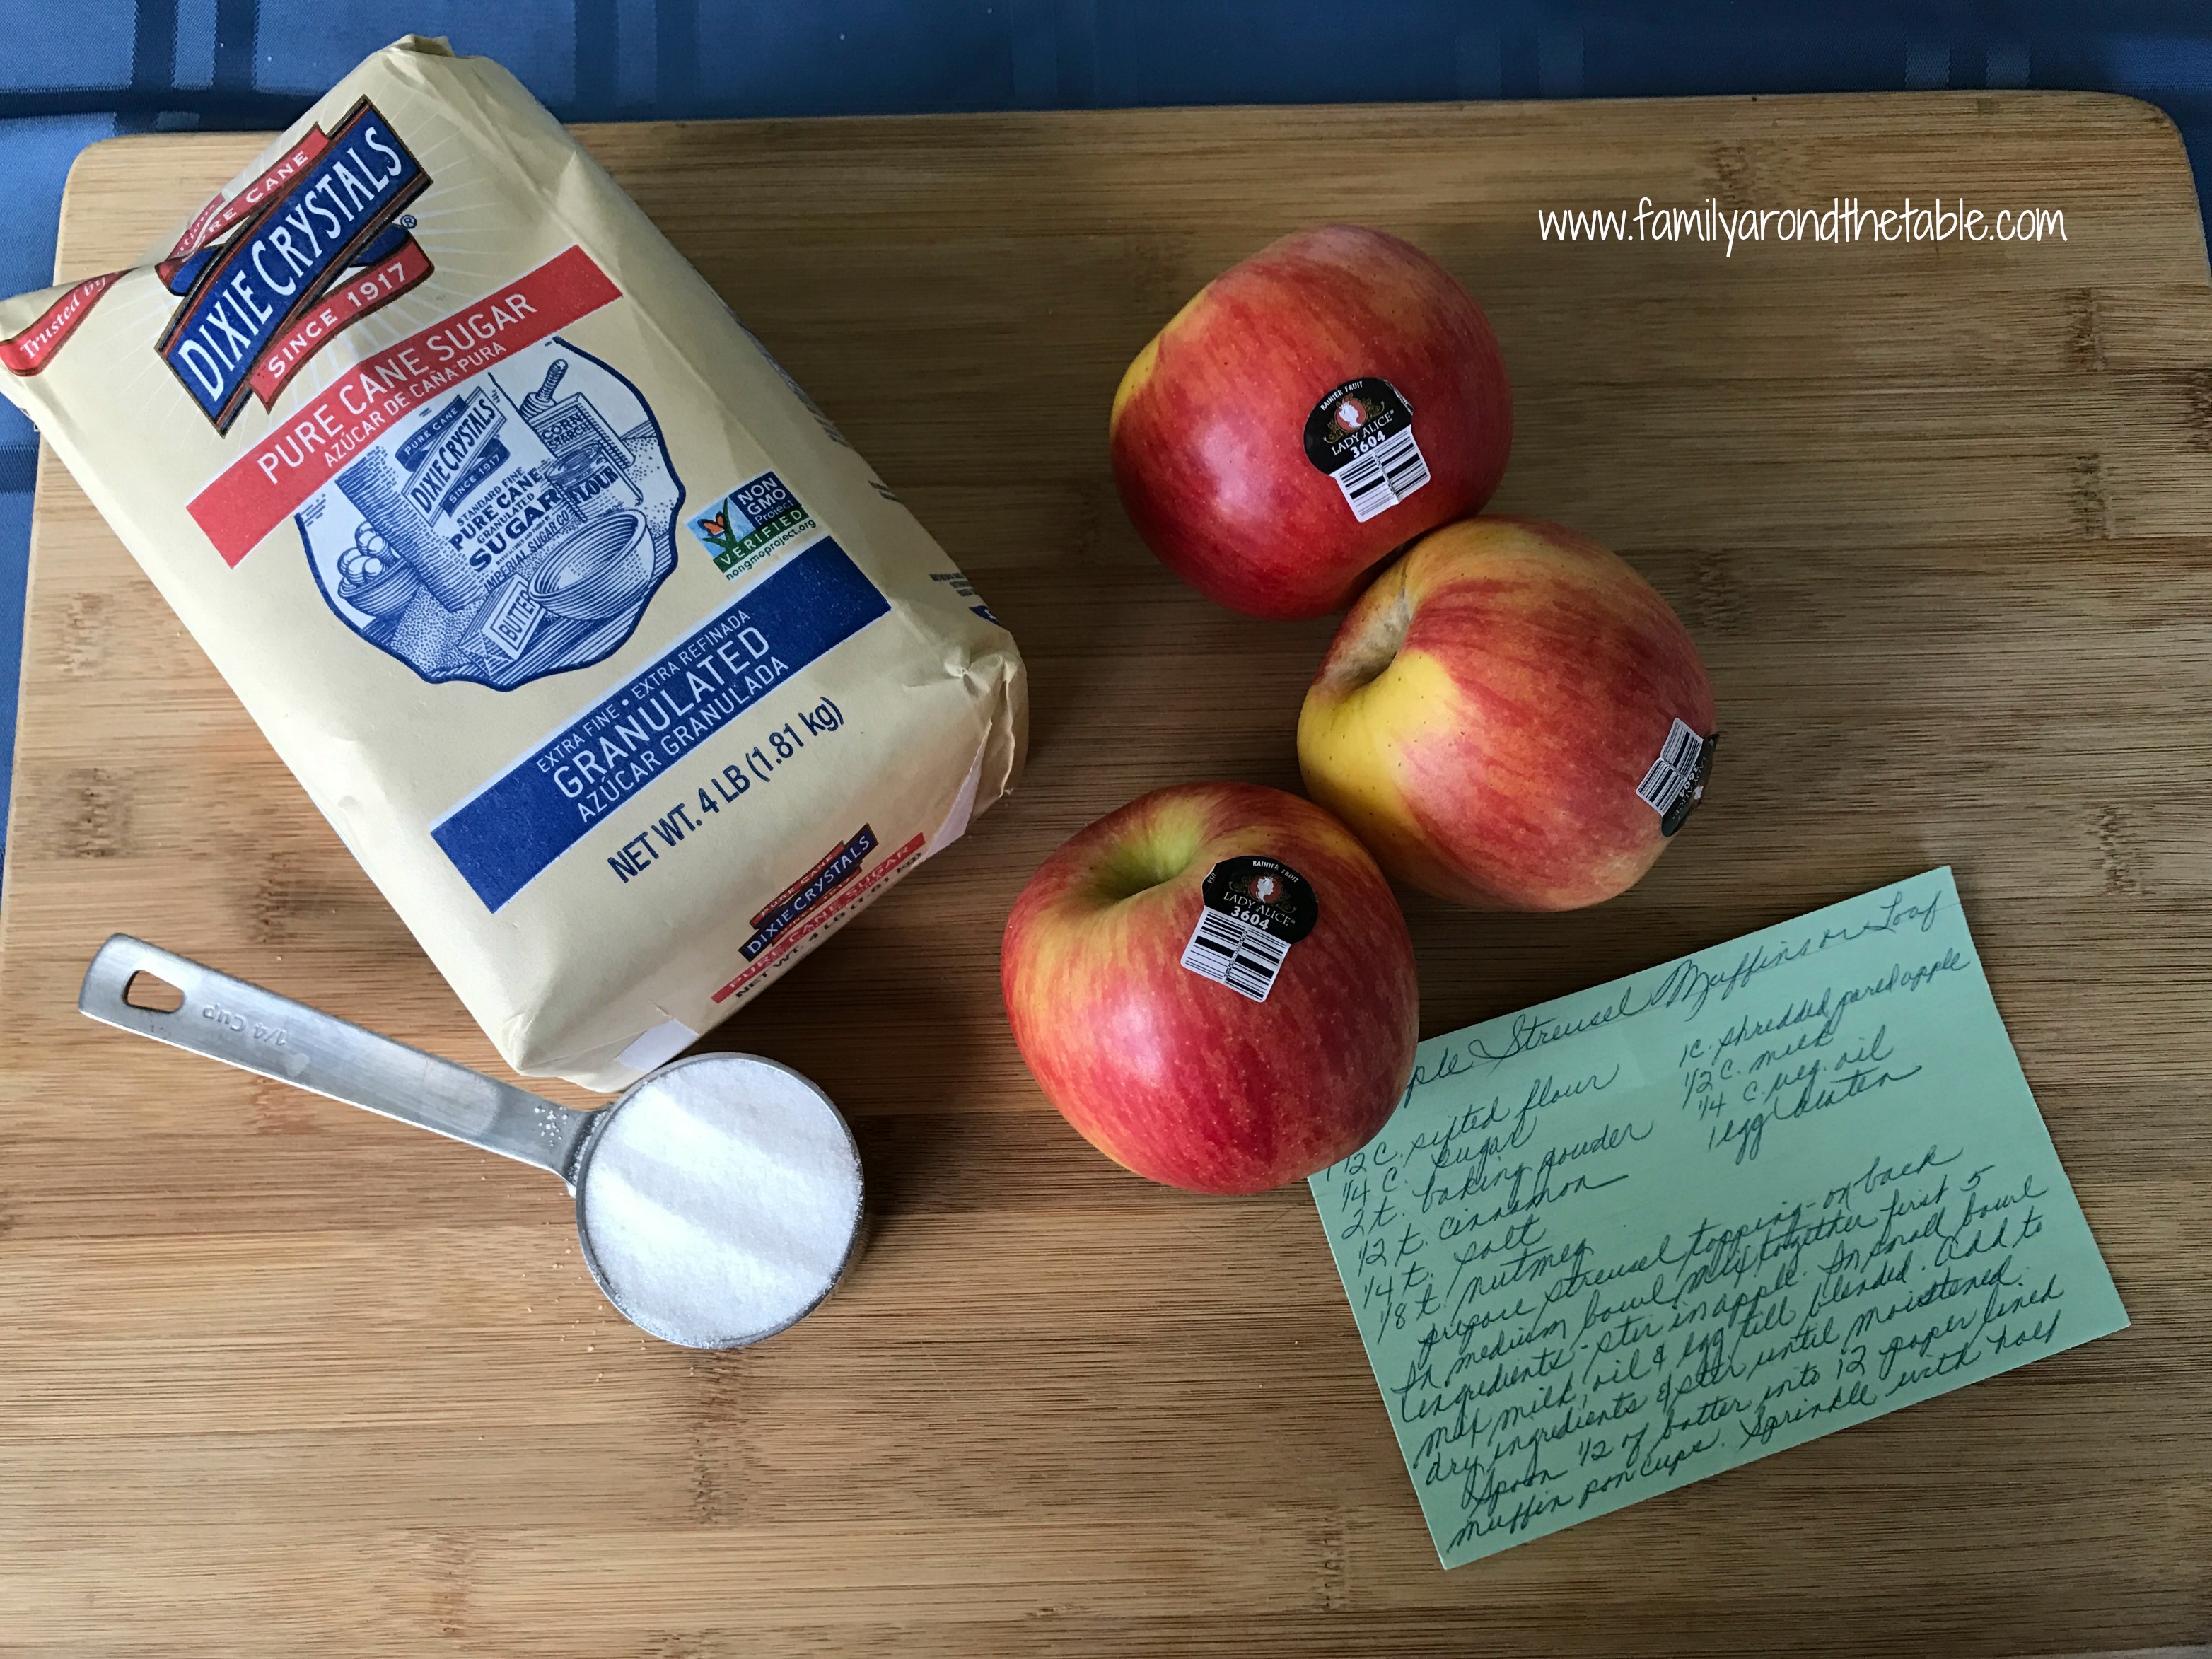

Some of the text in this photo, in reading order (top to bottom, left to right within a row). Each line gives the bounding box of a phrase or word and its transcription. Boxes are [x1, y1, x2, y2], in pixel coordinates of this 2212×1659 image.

[246, 151, 308, 203] CANE
[178, 127, 403, 401] DIXIE CRYSTALS
[20, 276, 106, 359] Trusted by
[268, 262, 407, 378] SINCE 1917
[257, 293, 537, 484] PURE CANE SUGAR
[324, 342, 506, 467] AZÚCAR DE CAÑA PURA
[404, 407, 459, 455] PURE CANE
[542, 413, 584, 440] CORN
[1320, 380, 1363, 411] RAINIER FRUIT
[413, 398, 496, 514] DIXIE CRYSTALS
[1331, 413, 1392, 456] LADY ALICE
[1350, 430, 1386, 458] 3604
[448, 467, 544, 552] PURE CANE
[449, 455, 501, 504] SINCE 1917
[457, 466, 525, 527] STANDARD FINE
[477, 493, 535, 545] GRANULATED
[566, 466, 619, 503] FLOUR
[738, 477, 778, 506] NON
[747, 488, 787, 515] GMO
[469, 488, 564, 573] SUGAR
[483, 549, 528, 594] IMPERIAL
[528, 521, 557, 554] SUGAR
[720, 509, 802, 565] VERIFIED
[726, 519, 817, 581] nongmoproject.org
[499, 590, 534, 642] BUTTER
[537, 610, 751, 772] EXTRA FINE EXTRA REFINADA
[553, 627, 770, 798] GRANULATED
[578, 657, 789, 823] AZÚCAR GRANULADA
[1679, 764, 1699, 797] 3604
[607, 696, 844, 883] NET WT. 4 LB (1.81 kg)
[747, 909, 793, 953] DIXIE
[793, 835, 870, 911] CRYSTALS
[762, 854, 834, 916] PURE CANE
[1206, 872, 1217, 884] USA
[1223, 892, 1292, 926] LADY ALICE
[1252, 860, 1300, 883] RAINIER FRUIT
[730, 946, 782, 988] PURE
[788, 899, 841, 942] CANE
[846, 846, 909, 897] SUGAR
[1230, 906, 1270, 931] 3604
[202, 1003, 287, 1046] 1/4 Cup
[1468, 986, 1651, 1075] Streusel
[1651, 939, 1811, 1021] Muffins
[1867, 890, 1942, 933] Loaf
[1713, 987, 1831, 1066] shredded
[1901, 948, 1970, 993] apple
[1698, 1091, 1726, 1120] 1/4
[1834, 1025, 1894, 1071] oil
[1749, 1019, 1834, 1075] milk
[1402, 1064, 1619, 1168] sifted flour
[1774, 1064, 1922, 1119] beaten
[1341, 1208, 1364, 1239] 2
[1414, 1158, 1532, 1213] baking
[1535, 1122, 1653, 1198] powder
[1342, 1117, 1537, 1212] 1/4 sugar
[1439, 1174, 1629, 1240] cinnamon
[1363, 1275, 1392, 1309] 1/4
[1446, 1214, 1546, 1298] salt
[1377, 1239, 1594, 1344] 1/8 nutmeg
[1418, 1145, 1964, 1366] prepare streusel topping on back
[1445, 1320, 1566, 1386] medium
[1571, 1274, 1676, 1349] bowl
[1760, 1210, 1878, 1273] together
[1879, 1175, 1949, 1243] first
[1403, 1347, 1576, 1432] ingredients
[1668, 1302, 1706, 1332] in
[1861, 1207, 1950, 1273] small
[1955, 1175, 2048, 1238] bowl
[1413, 1409, 1490, 1469] mix
[1593, 1351, 1649, 1391] oil
[1426, 1453, 1484, 1508] dry
[1485, 1393, 1648, 1481] ingredients
[1747, 1317, 1840, 1381] until
[1446, 1491, 1574, 1554] muffin
[1578, 1470, 1635, 1509] pan
[1739, 1381, 1877, 1449] Sprinkle
[1885, 1337, 1981, 1397] with
[1987, 1310, 2061, 1354] half
[1470, 1467, 1568, 1518] Spoon
[1648, 1396, 1751, 1453] batter
[1754, 1361, 1820, 1413] into
[1837, 1345, 1866, 1380] 12
[1879, 1308, 1977, 1379] paper
[1973, 1274, 2063, 1342] lined
